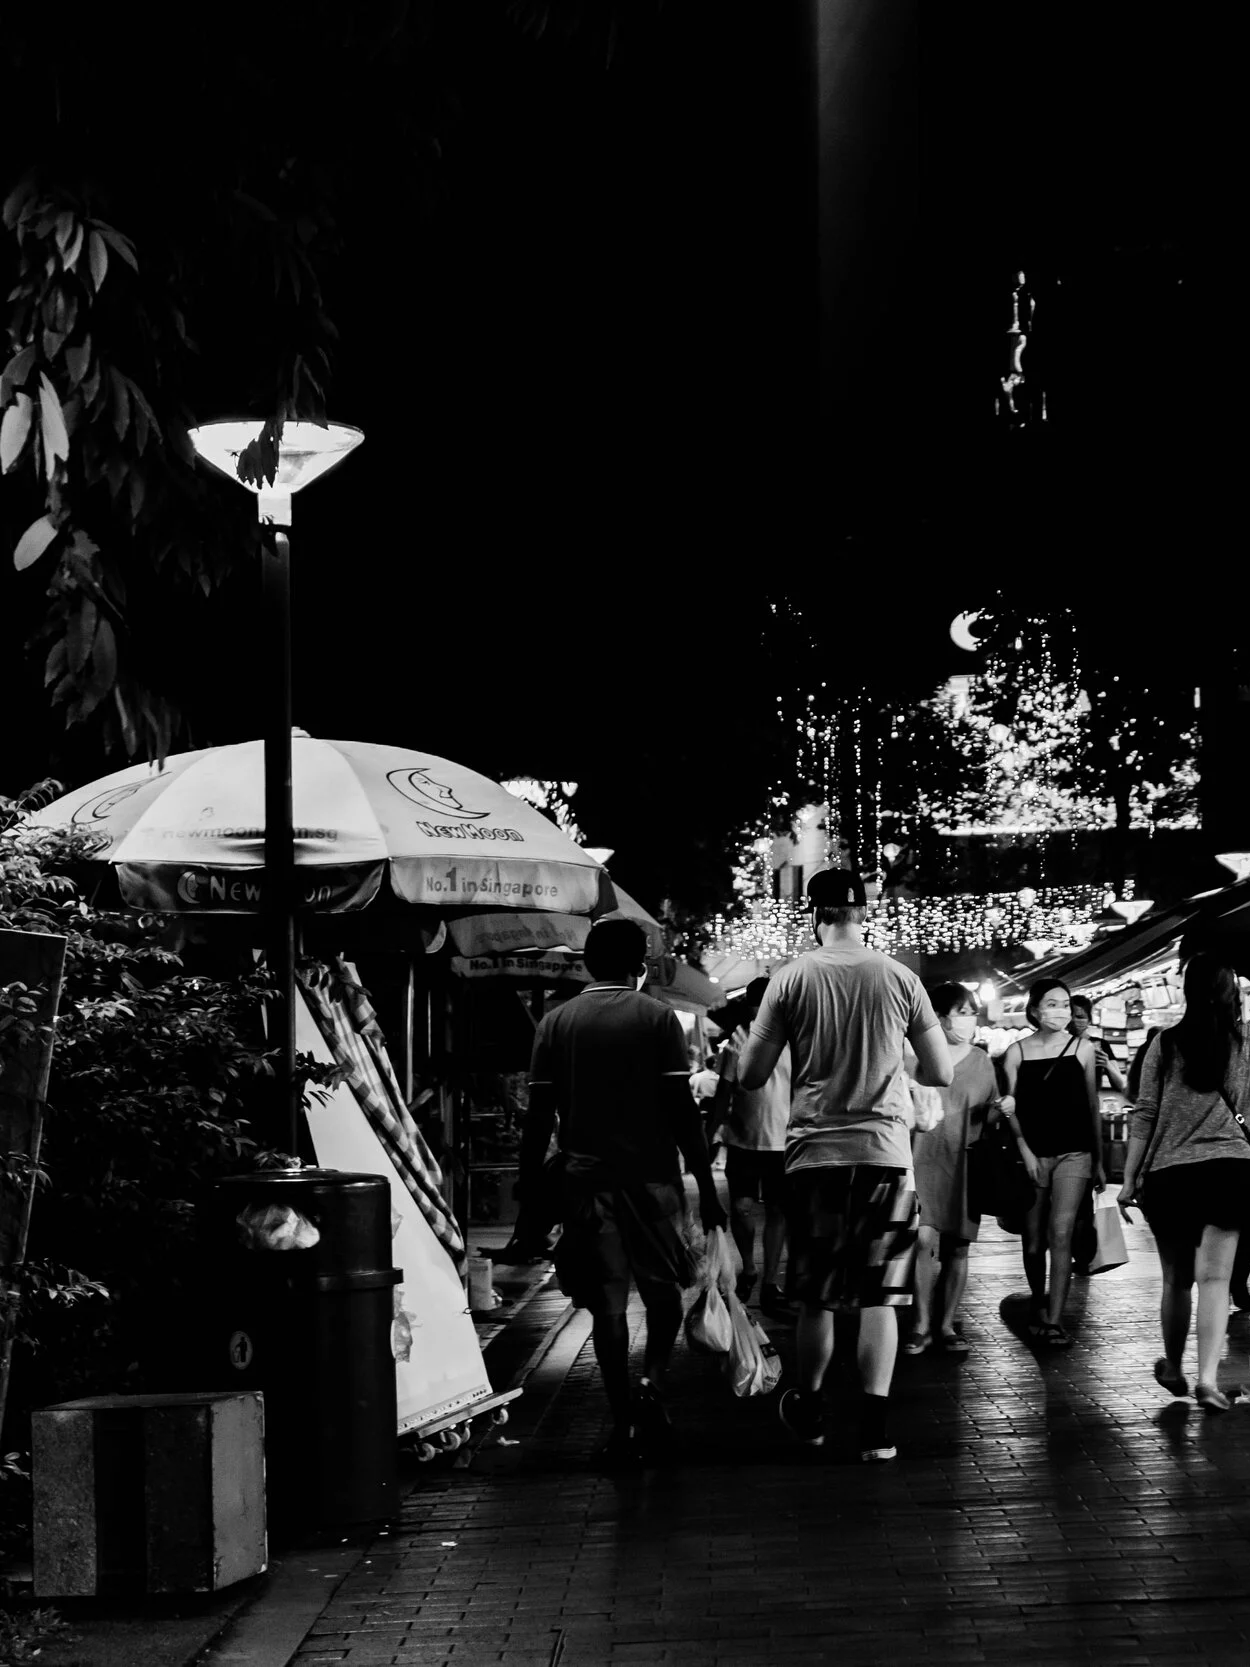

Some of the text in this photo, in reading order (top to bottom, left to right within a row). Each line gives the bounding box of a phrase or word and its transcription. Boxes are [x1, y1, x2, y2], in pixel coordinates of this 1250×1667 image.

[161, 826, 338, 842] newmoon.m.sg
[426, 866, 559, 898] No.1 in Singapore
